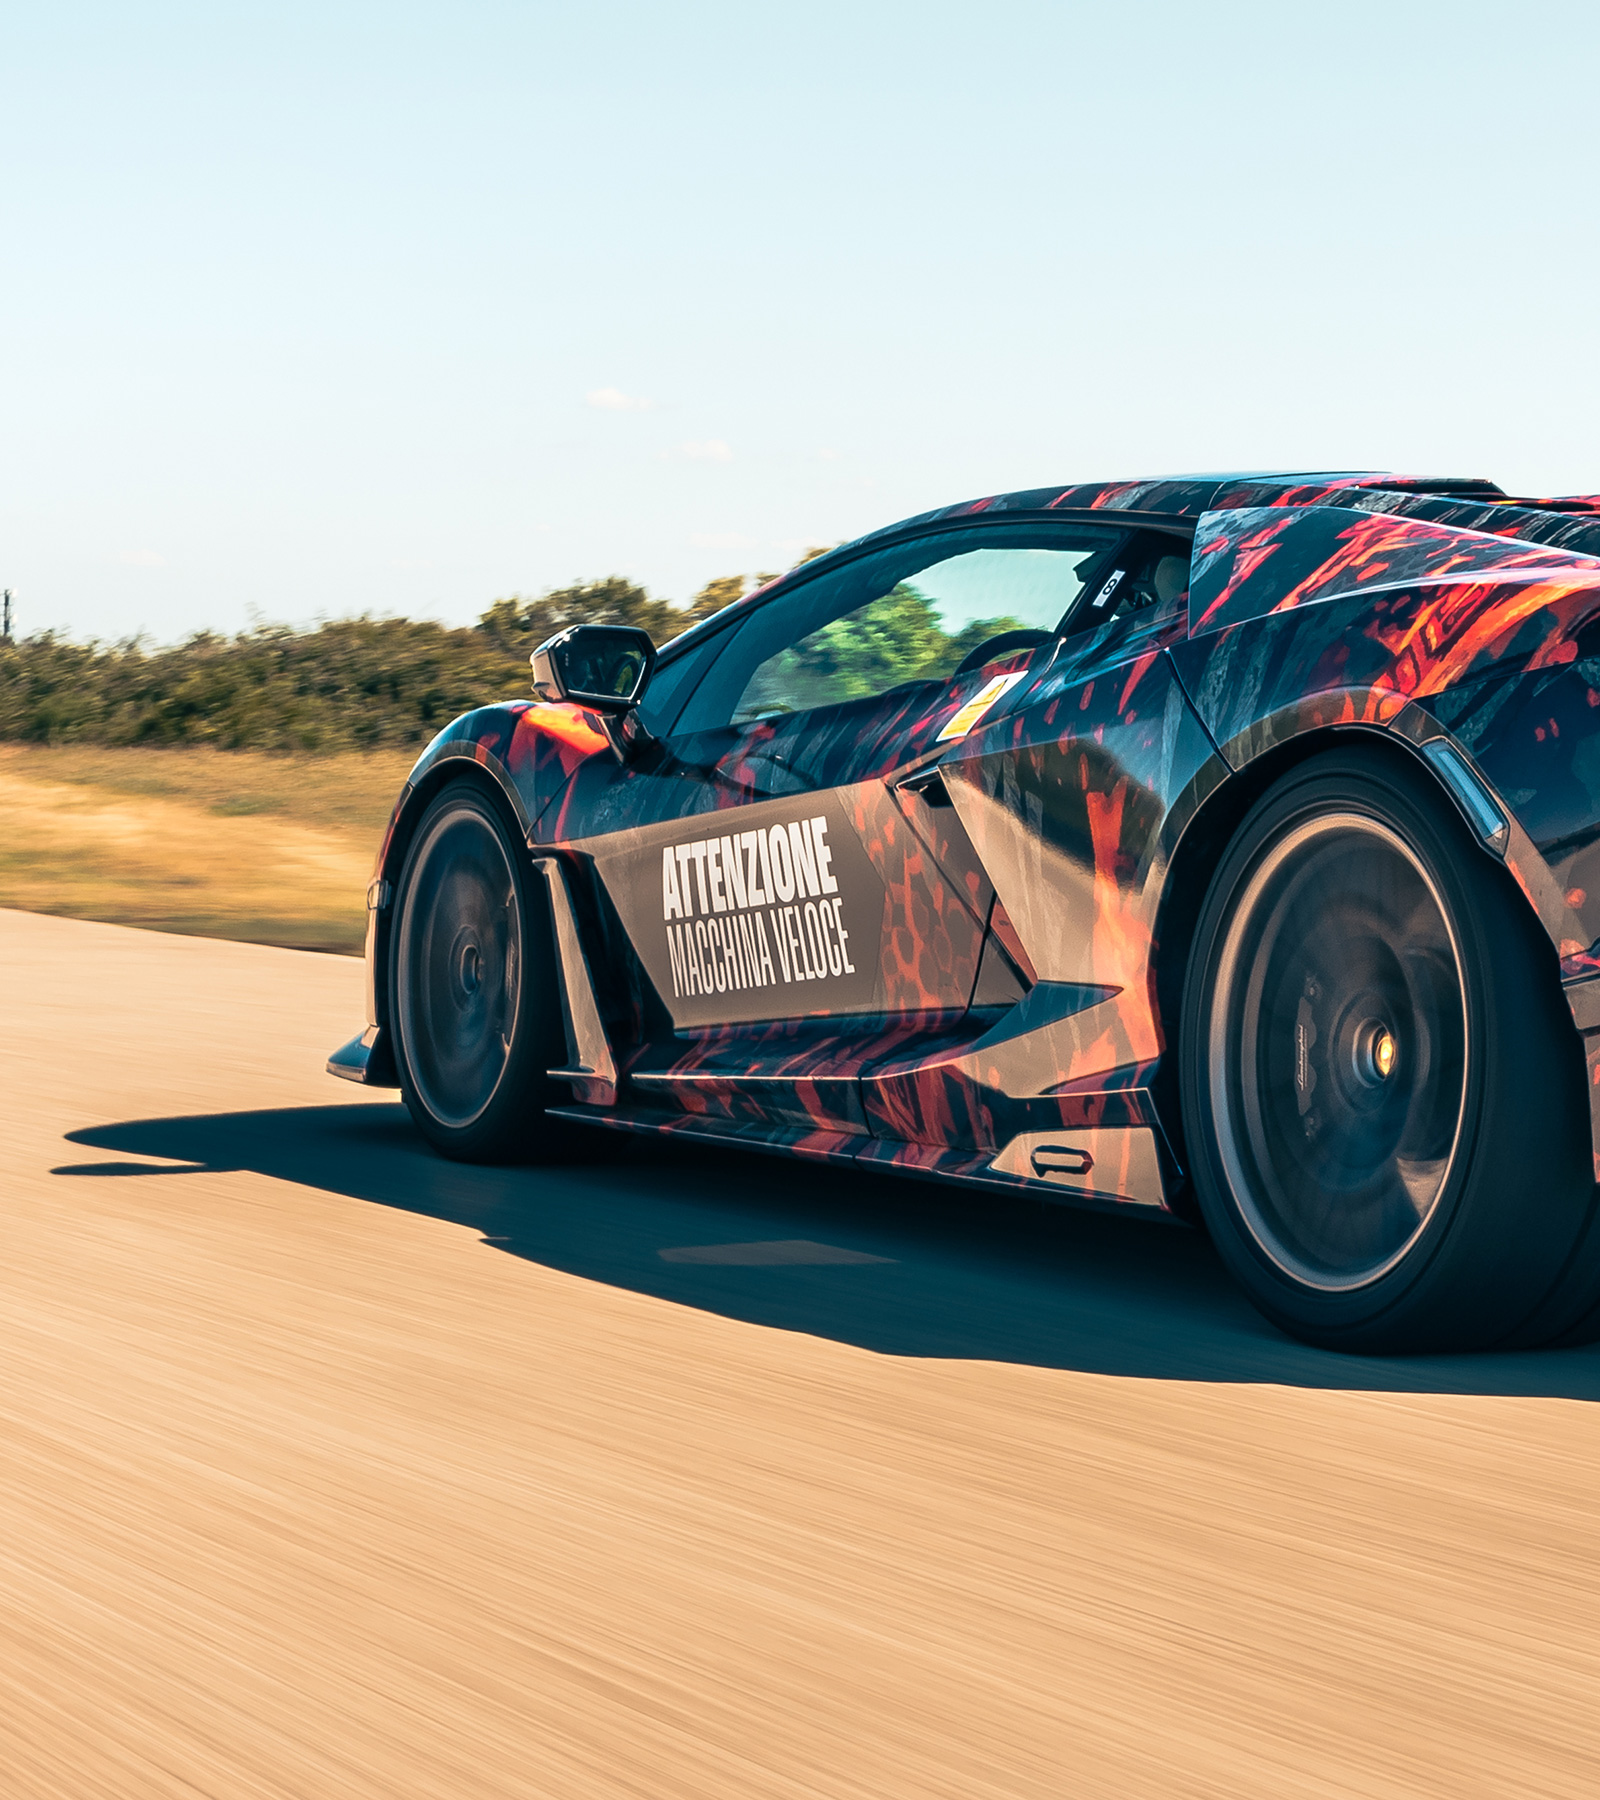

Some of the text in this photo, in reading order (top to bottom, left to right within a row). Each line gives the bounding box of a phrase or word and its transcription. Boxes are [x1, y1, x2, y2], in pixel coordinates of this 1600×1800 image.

[662, 816, 839, 921] ATTENZIONE
[666, 897, 856, 998] MACCHINA VELOCE
